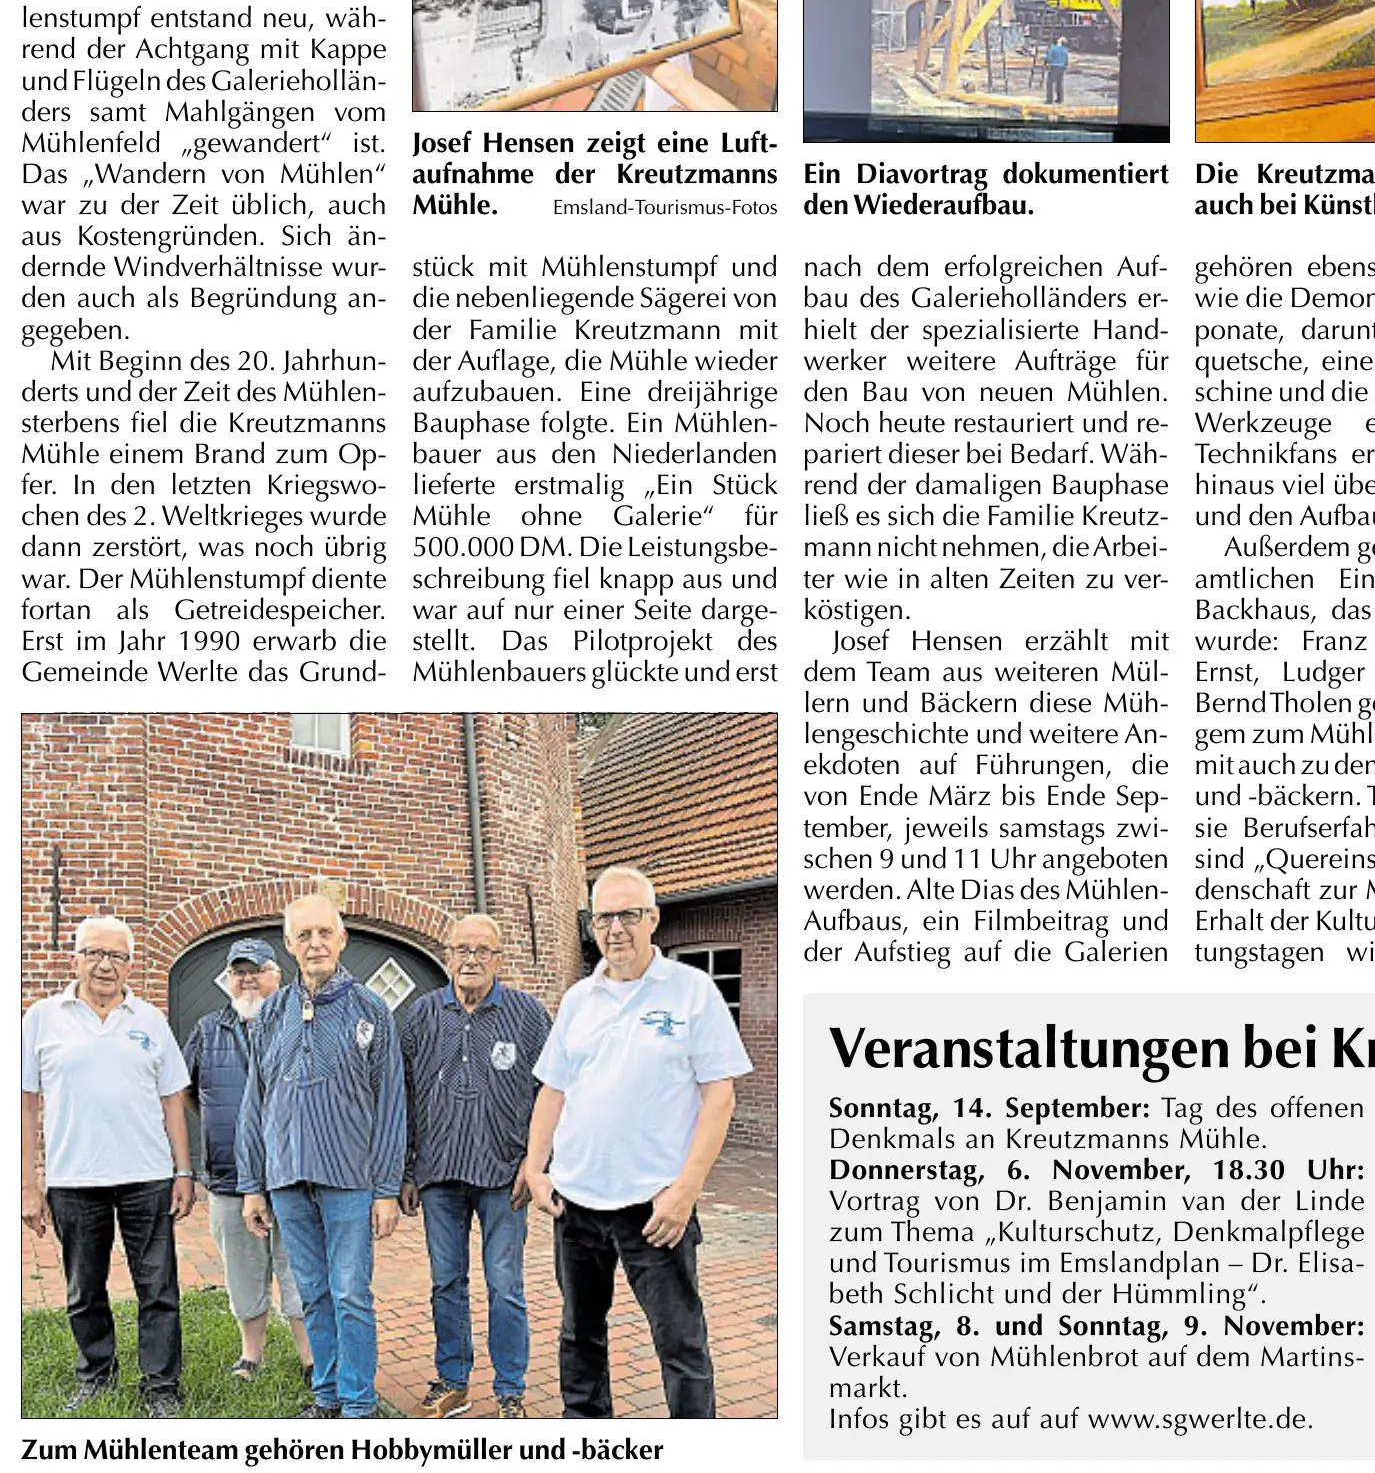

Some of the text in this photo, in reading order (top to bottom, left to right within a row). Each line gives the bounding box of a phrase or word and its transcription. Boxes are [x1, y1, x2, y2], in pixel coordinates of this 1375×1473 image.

[411, 130, 778, 161] Josef Hensen zeigt eine Luft-
[412, 160, 778, 185] aufnahme der Kreutzmanns
[804, 161, 1170, 192] Ein Diavortrag dokumentiert
[412, 192, 778, 216] Mühle. Emsland-Tourismus-Fotos
[803, 191, 1034, 216] den Wiederaufbau.
[413, 534, 778, 565] 500.000 DM. Die Leistungsbe-
[1196, 597, 1317, 625] Backhaus,
[1331, 597, 1372, 621] das
[831, 628, 1170, 655] Josef Hensen erzählt mit
[828, 1023, 1229, 1084] Veranstaltungen
[1244, 1023, 1317, 1069] bei
[829, 1095, 1364, 1126] Sonntag, 14. September: Tag des offenen
[829, 1375, 907, 1399] markt.
[20, 1437, 664, 1468] Zum Mühlenteam gehören Hobbymüller und -bäcker
